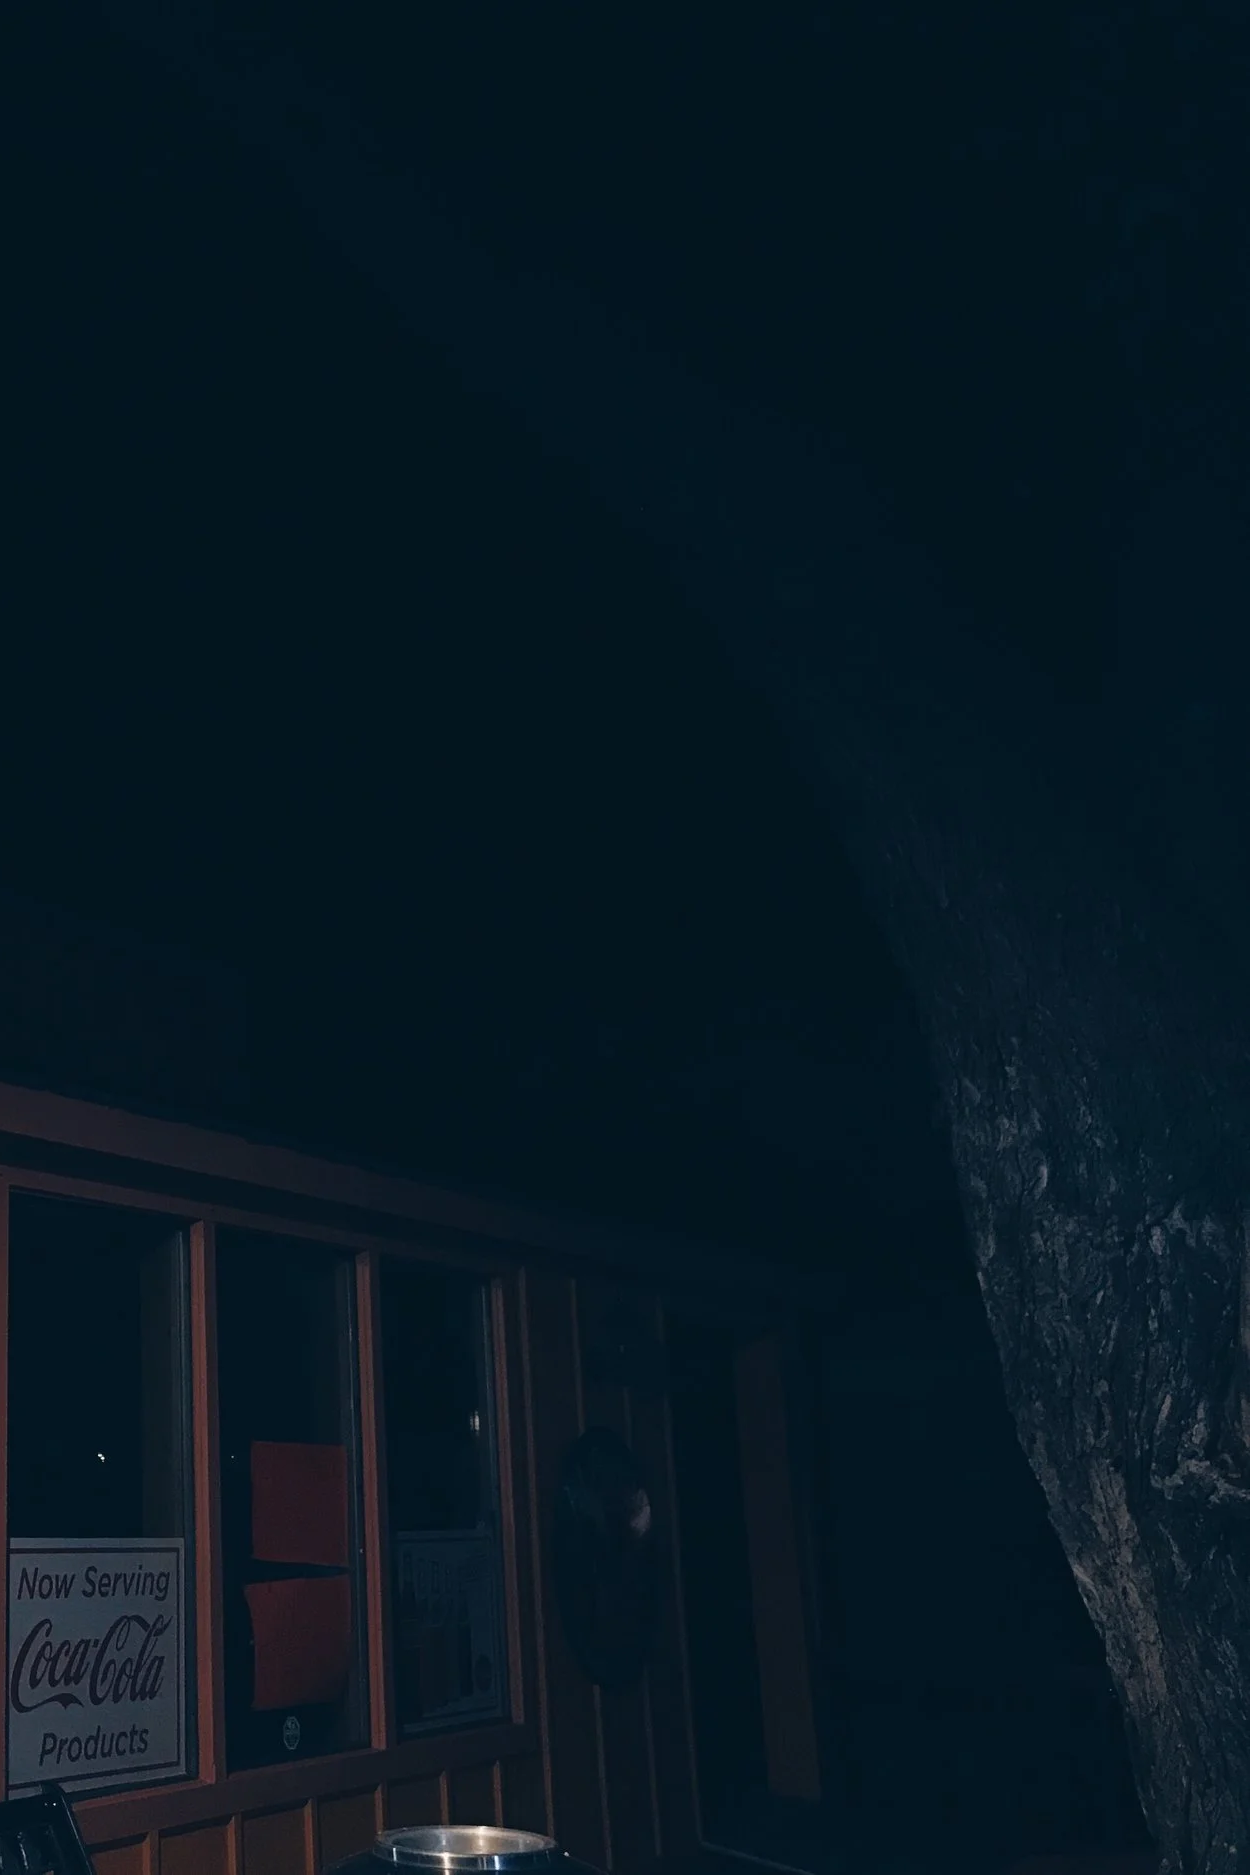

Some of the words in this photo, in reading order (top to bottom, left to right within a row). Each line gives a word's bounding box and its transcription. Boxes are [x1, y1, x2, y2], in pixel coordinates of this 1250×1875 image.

[17, 1567, 76, 1600] Now
[81, 1565, 171, 1601] Serving
[11, 1614, 173, 1714] Coca-Cola
[39, 1724, 149, 1767] Products
